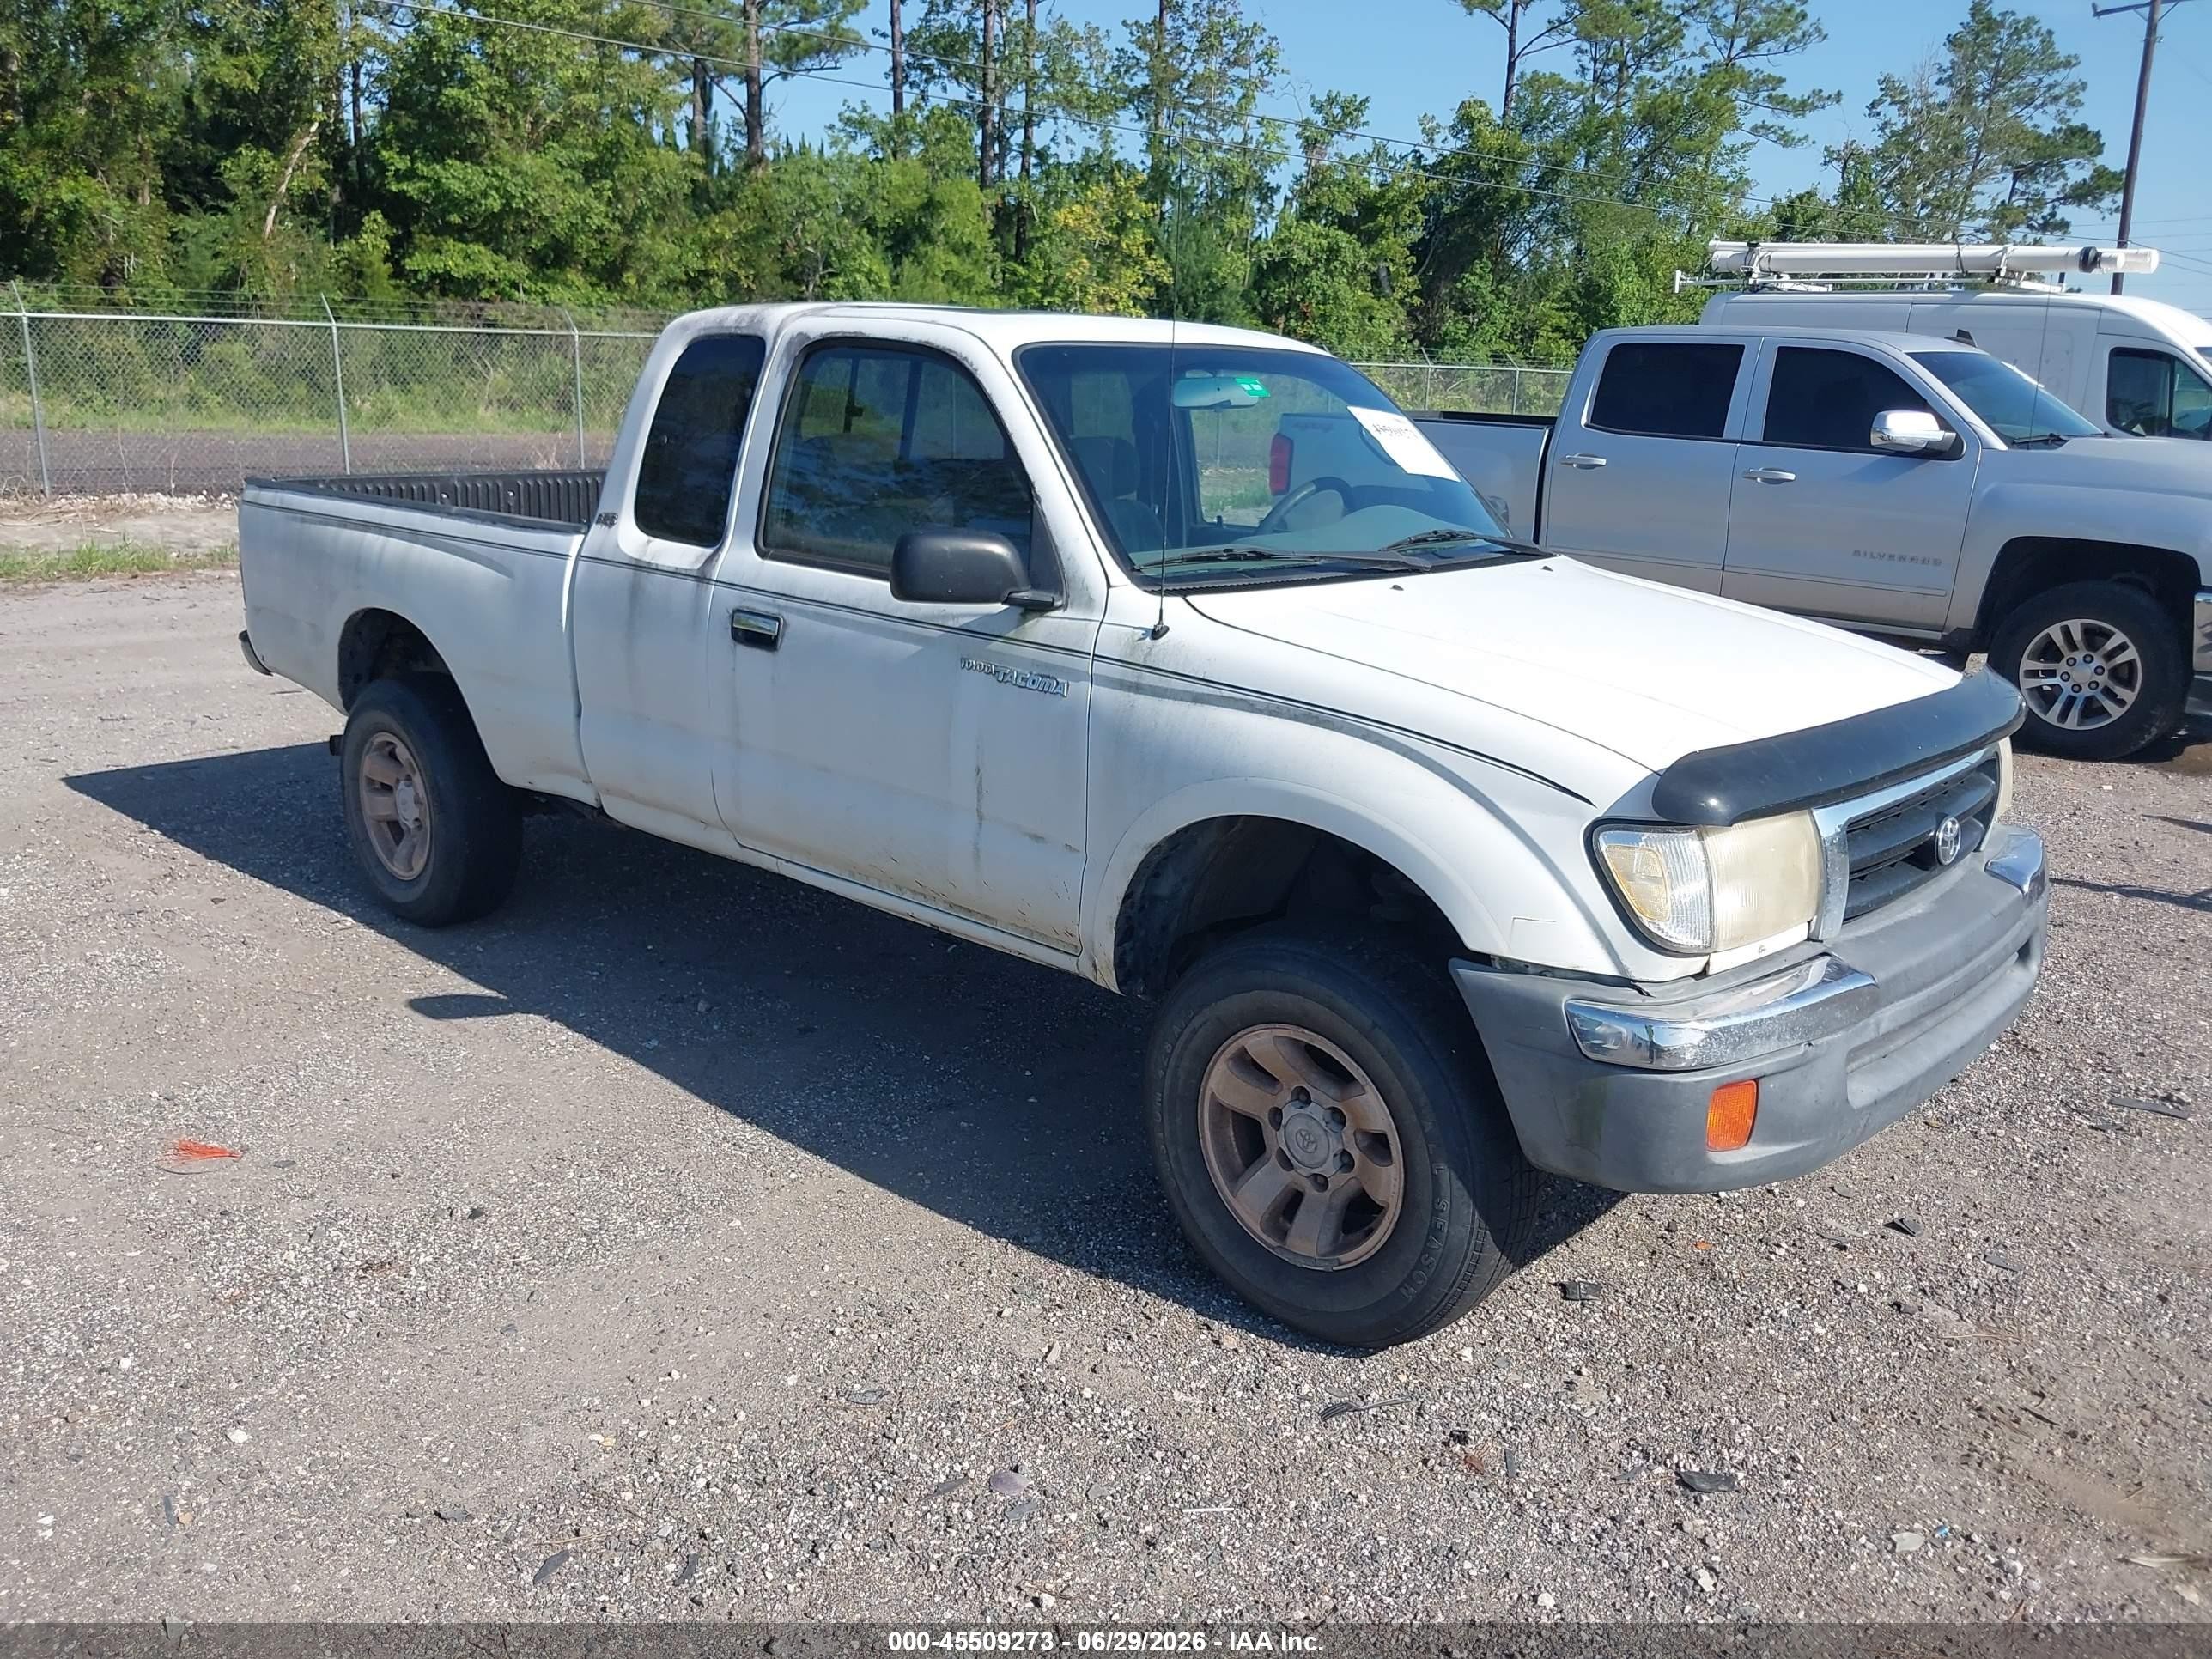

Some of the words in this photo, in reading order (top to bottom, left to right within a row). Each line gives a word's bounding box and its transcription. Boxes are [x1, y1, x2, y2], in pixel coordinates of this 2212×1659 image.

[1851, 549, 1942, 567] SILVERADO
[960, 658, 996, 675] TOYOTA
[996, 669, 1070, 697] TACOMA
[1399, 1198, 1449, 1302] SEASON
